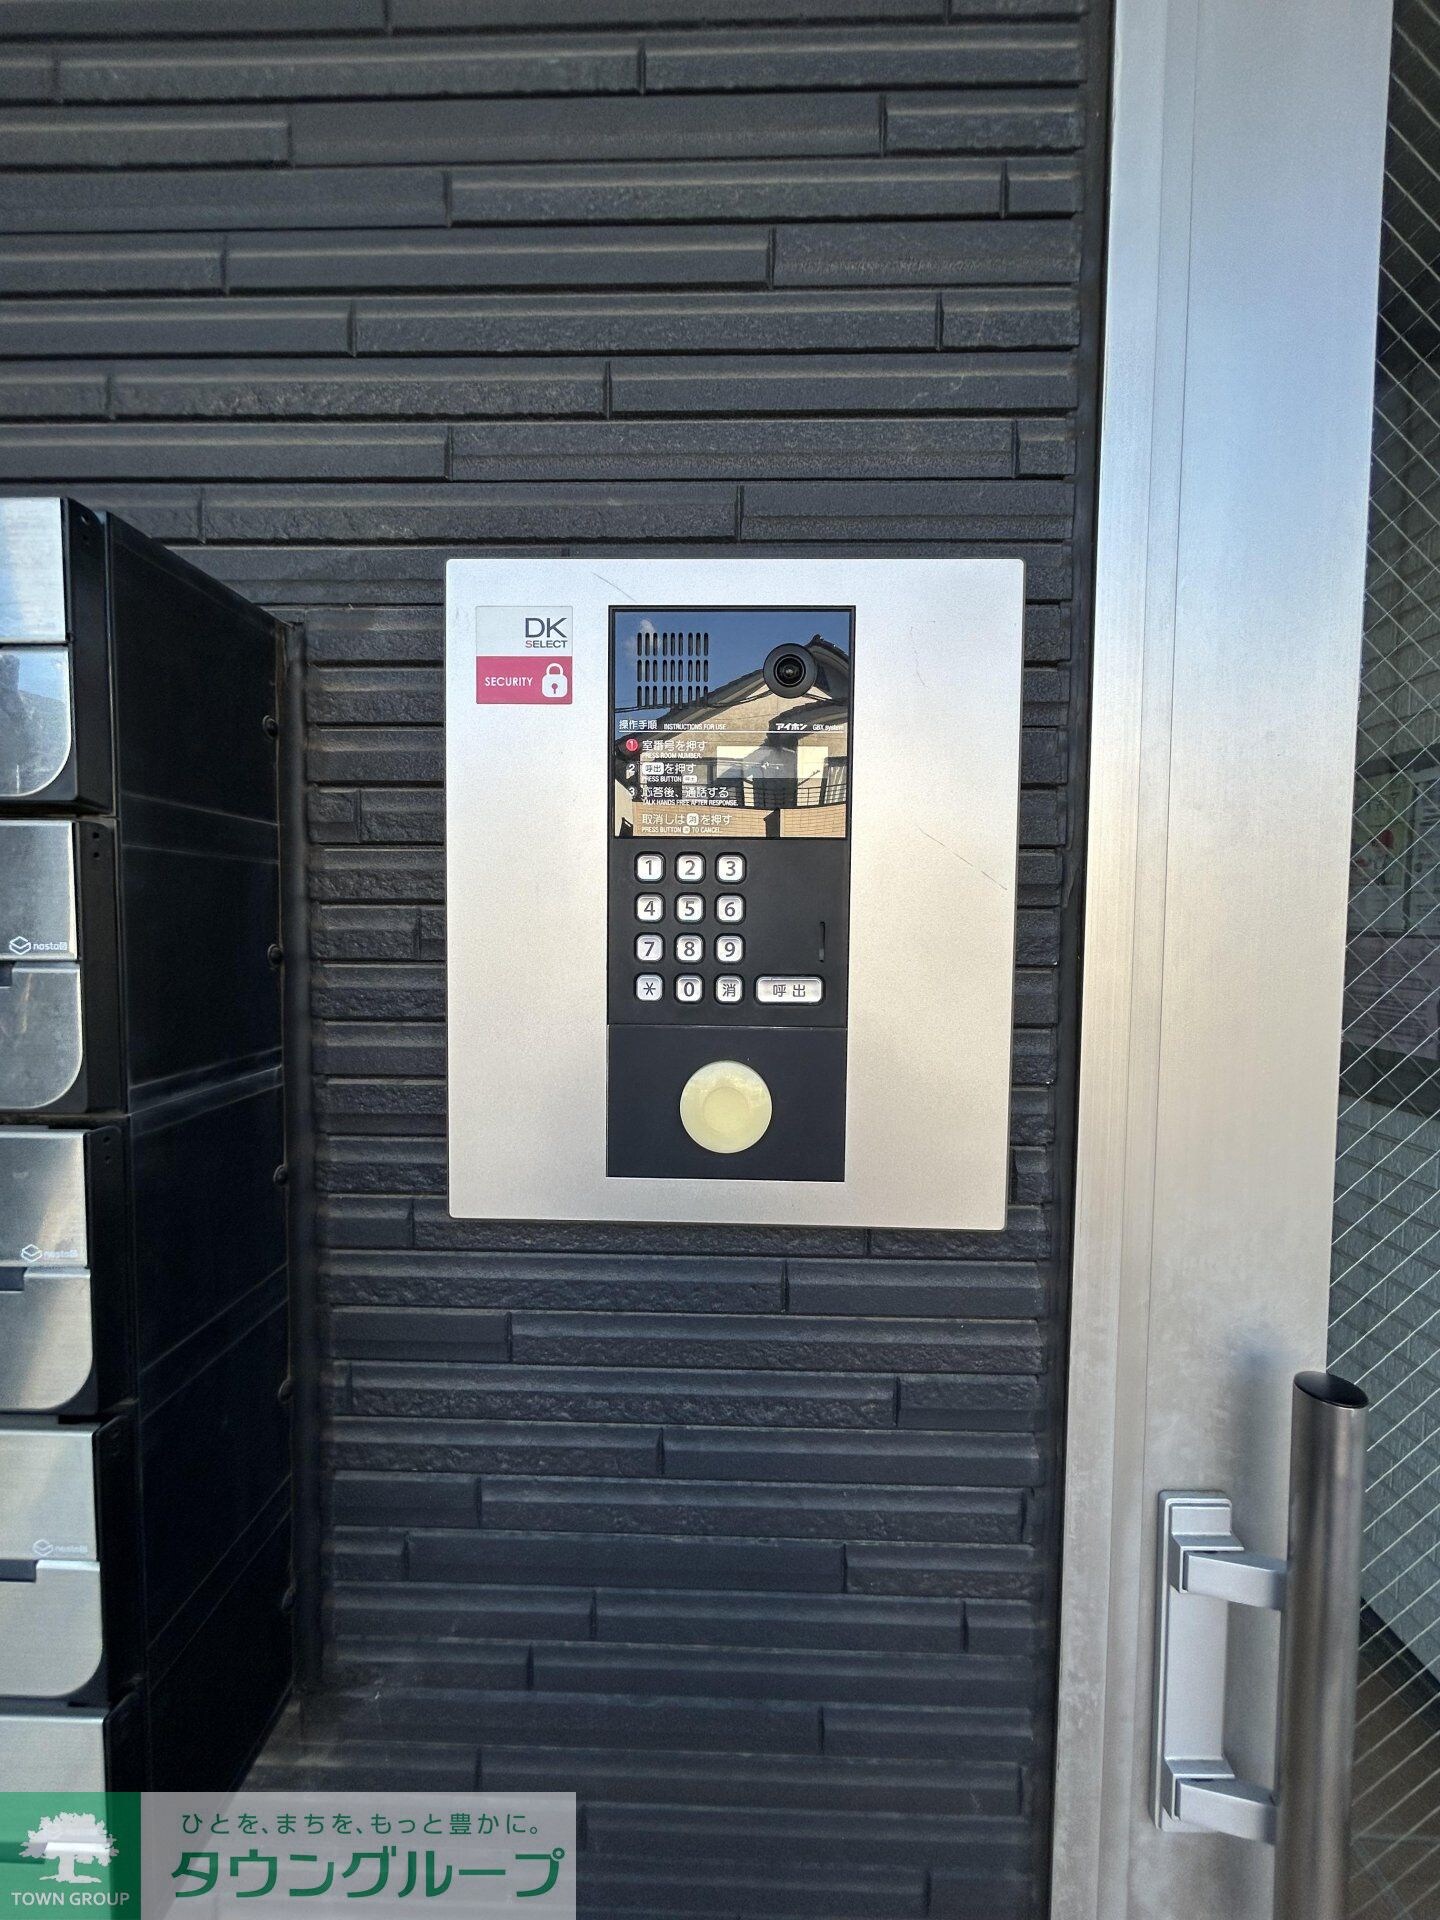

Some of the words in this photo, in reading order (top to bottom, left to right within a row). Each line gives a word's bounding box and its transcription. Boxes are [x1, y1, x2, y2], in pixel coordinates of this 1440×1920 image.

[525, 617, 568, 638] DK
[525, 640, 568, 648] SELECT
[484, 676, 533, 687] SECURITY
[619, 720, 658, 730] 操作手順
[775, 722, 808, 731] アイホン
[642, 740, 708, 752] 室番号を押す
[642, 775, 660, 783] PRESS
[660, 775, 681, 783] BUTTON
[645, 860, 653, 876] 1
[685, 860, 696, 876] 2
[726, 861, 736, 876] 3
[643, 901, 655, 916] 4
[684, 901, 695, 916] 5
[724, 902, 735, 917] 6
[644, 941, 655, 957] 7
[683, 941, 695, 957] 8
[724, 942, 736, 957] 9
[683, 981, 695, 997] 0
[722, 983, 736, 998] 消
[772, 984, 806, 998] 呼出
